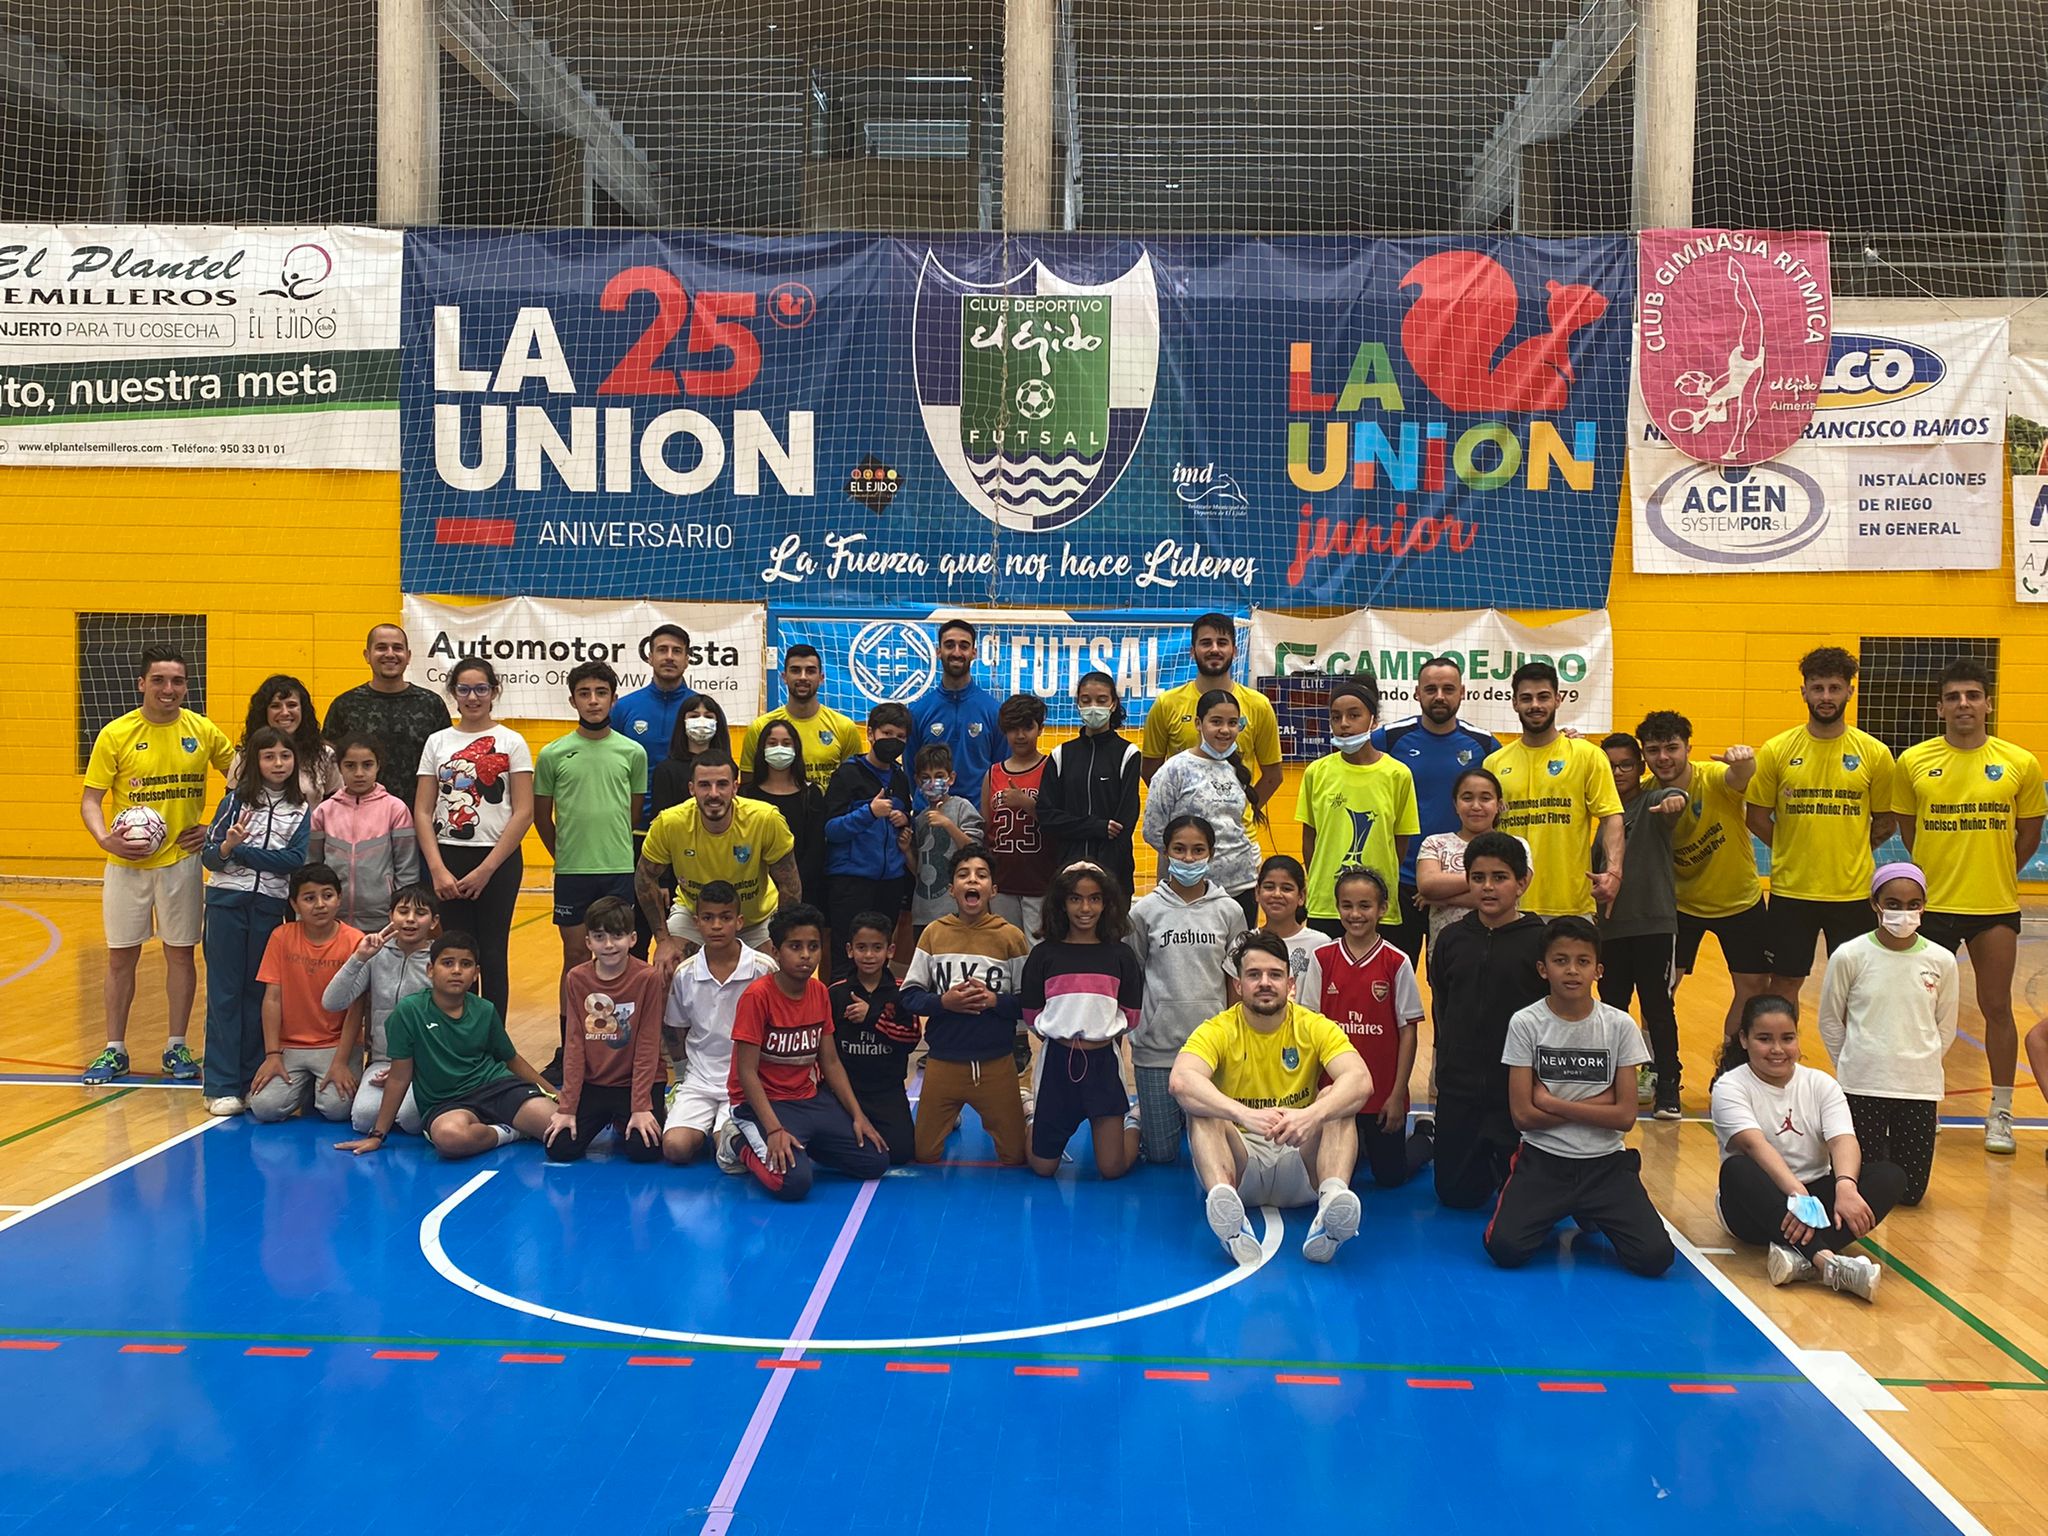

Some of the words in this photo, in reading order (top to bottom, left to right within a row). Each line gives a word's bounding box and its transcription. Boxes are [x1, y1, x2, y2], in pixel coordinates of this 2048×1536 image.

[0, 245, 47, 281] El
[66, 246, 246, 282] Plantel
[969, 299, 1009, 313] CLUB
[1014, 299, 1103, 313] DEPORTIVO
[1643, 292, 1666, 352] CLUB
[1773, 251, 1827, 344] RÍTMICA
[66, 322, 109, 337] PARA
[113, 322, 135, 338] TU
[140, 322, 220, 339] COSECHA
[249, 315, 264, 339] EL
[276, 315, 337, 339] EJIDO
[318, 323, 333, 331] club
[596, 265, 762, 396] 25
[434, 305, 577, 394] LA
[69, 369, 221, 406] nuestra
[238, 363, 338, 399] meta
[1288, 342, 1405, 412] LA
[969, 430, 1099, 445] FUTSAL
[1802, 420, 1906, 439] RANCISCO
[1912, 417, 1990, 437] RAMOS
[18, 442, 163, 454] www.elplantelsemilleros.com
[172, 442, 218, 454] Teléfono:
[220, 443, 239, 454] 950
[242, 443, 255, 454] 33
[258, 443, 271, 455] 01
[274, 443, 286, 455] 01
[434, 404, 815, 497] UNION
[1172, 461, 1215, 484] imd
[1858, 472, 1987, 488] INSTALACIONES
[850, 481, 863, 492] EL
[866, 481, 898, 493] EJIDO
[1681, 476, 1787, 514] ACIÉN
[1858, 498, 1879, 511] DE
[1884, 497, 1933, 511] RIEGO
[538, 520, 733, 549] ANIVERSARIO
[1858, 523, 1880, 536] EN
[1884, 521, 1961, 536] GENERAL
[1286, 502, 1479, 587] junior
[761, 533, 818, 583] La
[825, 531, 929, 580] Fuerza
[940, 551, 994, 587] que
[1005, 552, 1051, 583] nos
[1060, 541, 1132, 579] hace
[427, 630, 626, 663] Automotor
[638, 635, 739, 667] Csta
[1010, 633, 1166, 698] FUTSAL
[618, 673, 645, 688] MW
[688, 673, 739, 691] lmería
[1301, 680, 1325, 689] ELITE
[1278, 725, 1297, 735] CAL
[993, 808, 1042, 853] 23
[1923, 818, 1958, 831] ancisco
[1158, 929, 1217, 949] Fashion
[936, 961, 1003, 993] NYC
[1348, 1010, 1363, 1023] Fly
[860, 1031, 876, 1044] Fly
[1335, 1020, 1384, 1036] mirates
[1541, 1055, 1567, 1066] NEW
[1570, 1056, 1605, 1068] YORK
[1233, 1097, 1277, 1110] MINISTROS
